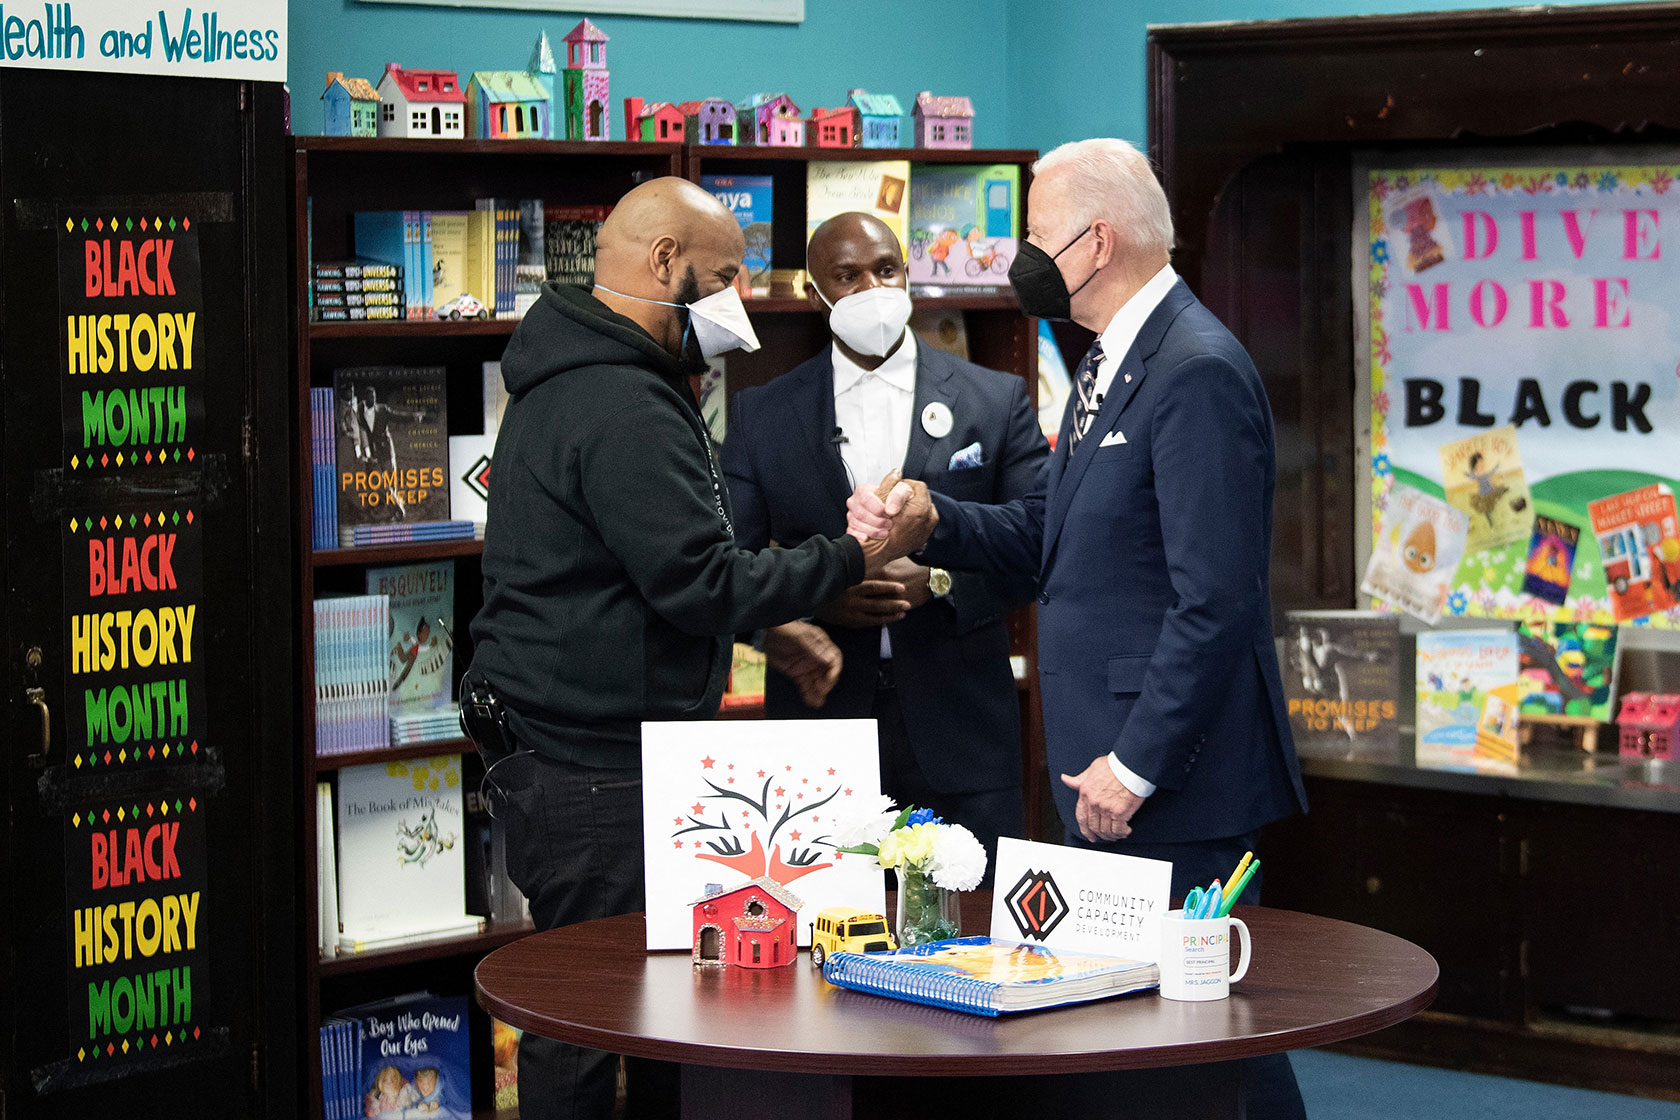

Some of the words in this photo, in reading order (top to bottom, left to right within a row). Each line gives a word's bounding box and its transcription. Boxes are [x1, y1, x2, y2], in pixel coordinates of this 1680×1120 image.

[0, 3, 85, 60] ealth
[100, 20, 153, 59] and
[158, 8, 279, 62] Wellness
[1457, 209, 1662, 261] DIVE
[85, 238, 175, 298] BLACK
[1404, 278, 1632, 333] MORE
[67, 312, 195, 374] HISTORY
[81, 386, 187, 449] MONTH
[1403, 376, 1655, 434] BLACK
[342, 467, 444, 492] PROMISES
[358, 492, 380, 507] TO
[385, 489, 428, 506] KEEP
[88, 533, 177, 597] BLACK
[379, 568, 448, 597] ESQUIVEL!
[71, 604, 196, 674] HISTORY
[85, 679, 188, 747] MONTH
[1288, 698, 1397, 719] PROMISES
[1307, 716, 1328, 730] TO
[347, 804, 367, 817] The
[369, 799, 397, 815] Book
[398, 798, 410, 810] of
[413, 797, 460, 817] Mistakes
[91, 822, 181, 890] BLACK
[1077, 906, 1144, 929] CAPACITY
[1078, 889, 1155, 912] COMMUNITY
[74, 892, 199, 967] HISTORY
[1075, 923, 1141, 942] DEVELOPMENT
[88, 966, 192, 1039] MONTH
[368, 1015, 395, 1039] Boy
[397, 1011, 421, 1032] Who
[422, 1011, 461, 1032] Opened
[380, 1038, 401, 1057] Our
[404, 1032, 429, 1057] Eyes
